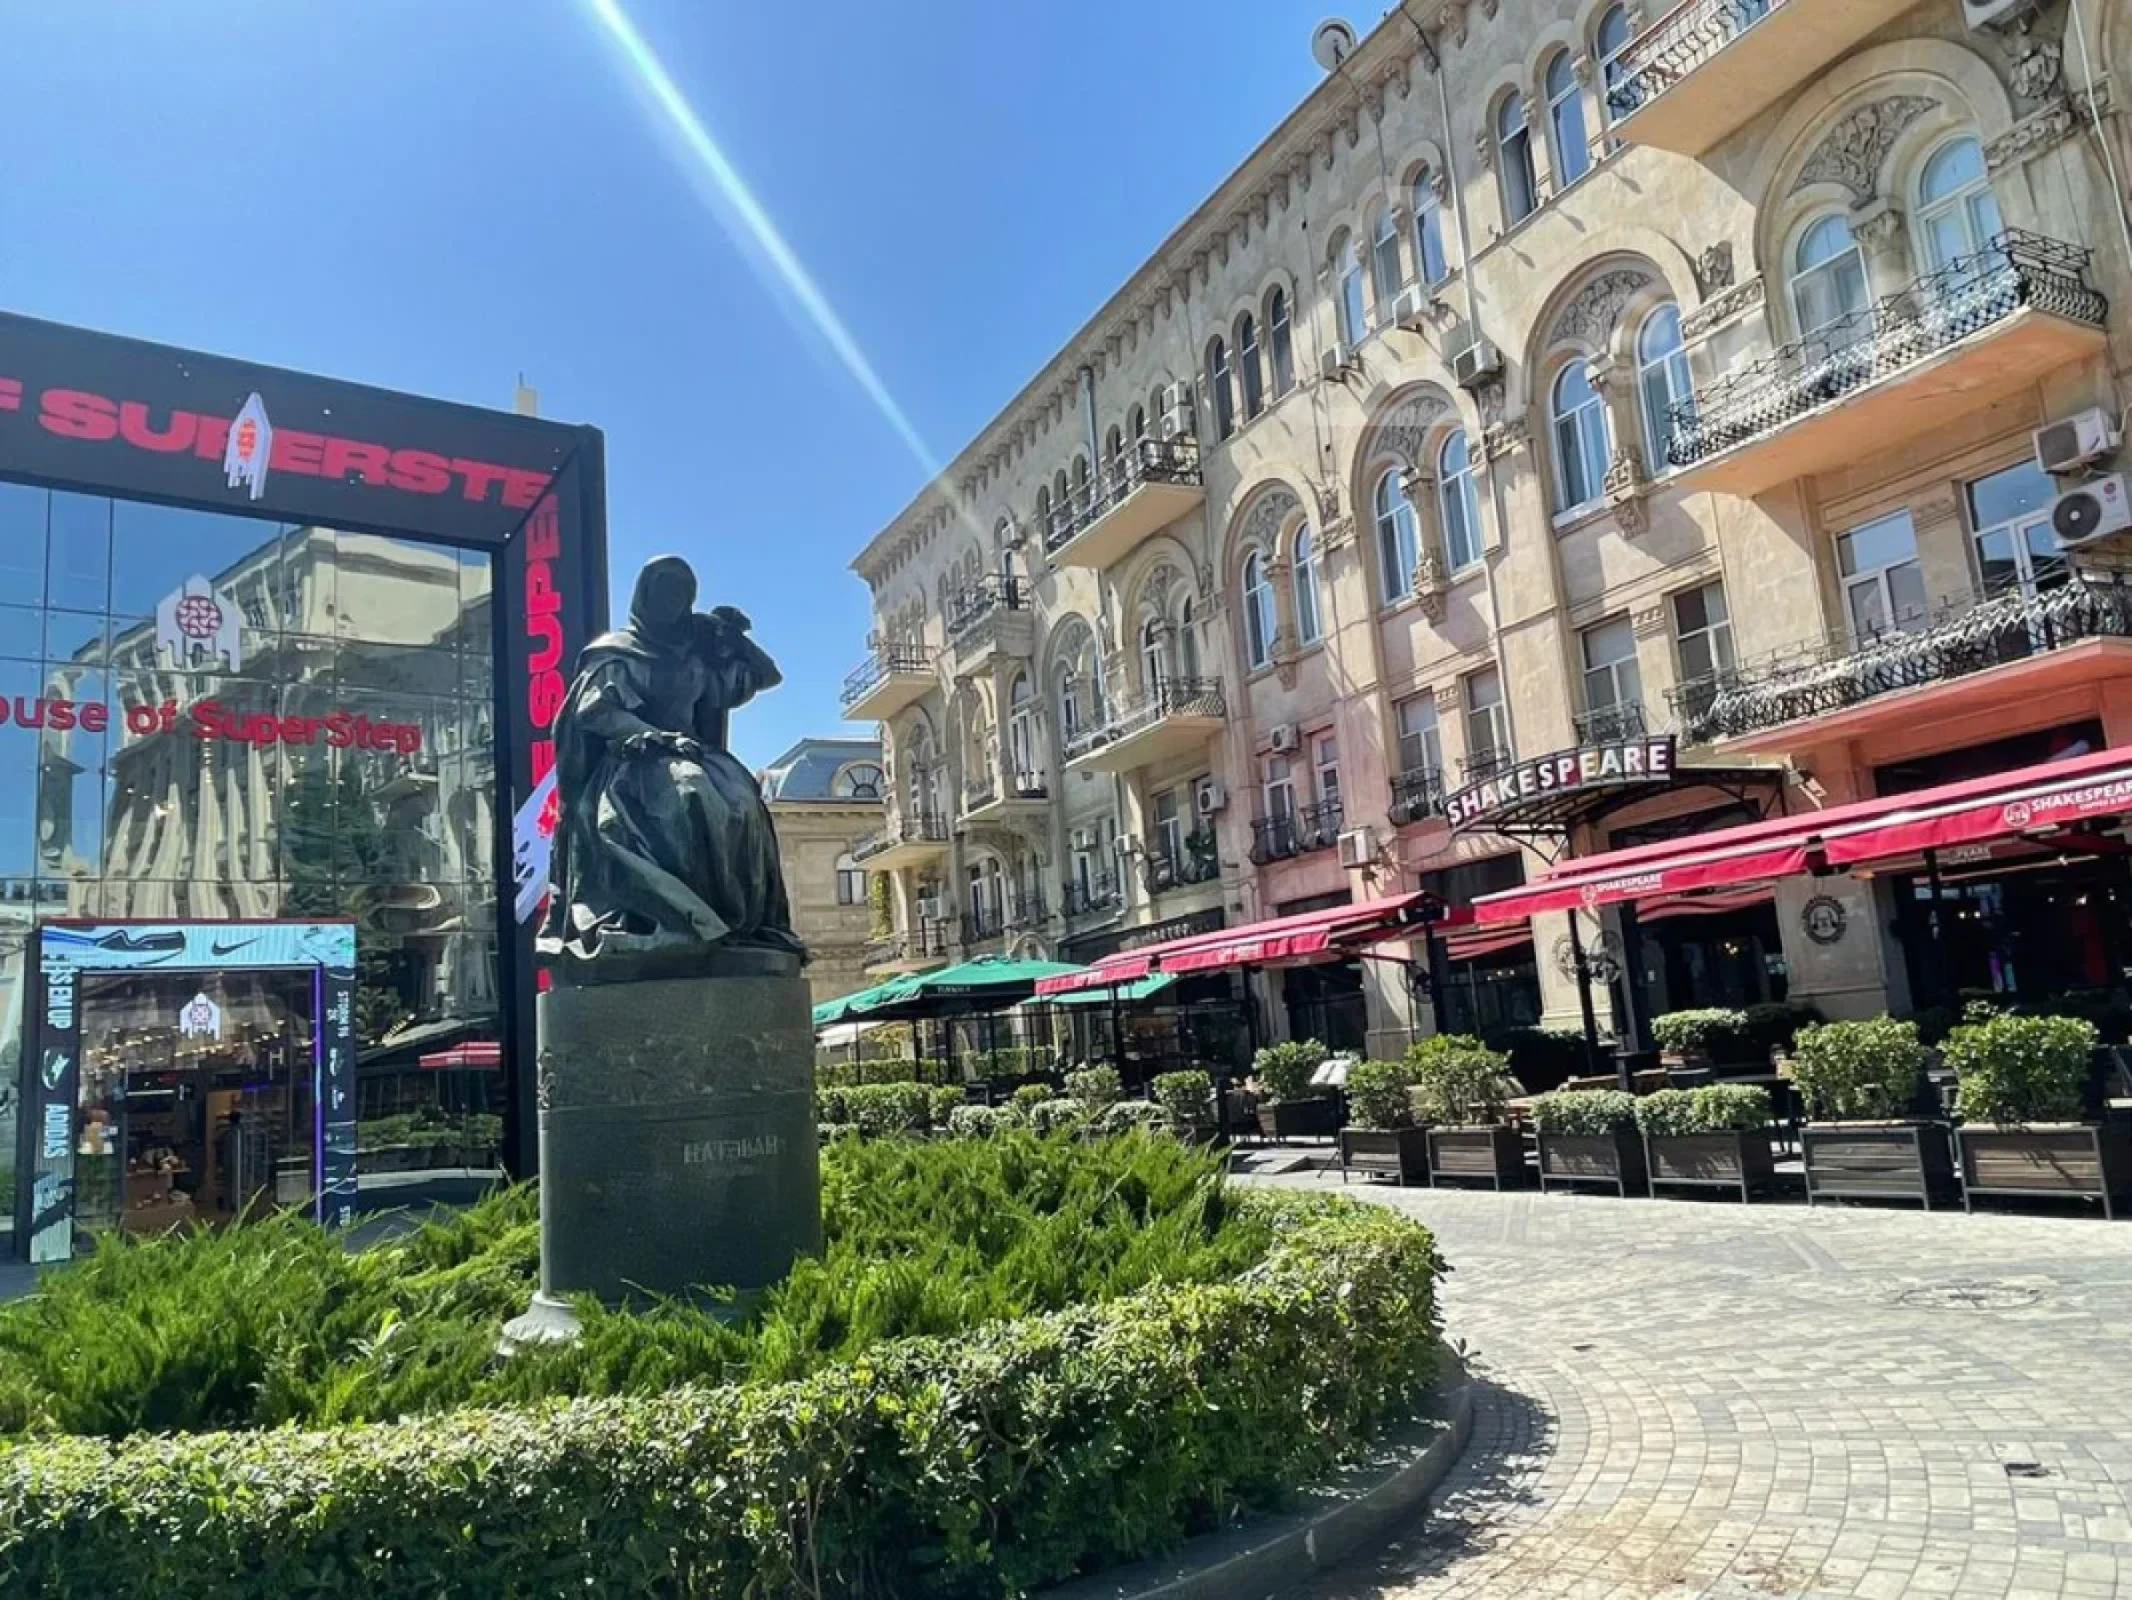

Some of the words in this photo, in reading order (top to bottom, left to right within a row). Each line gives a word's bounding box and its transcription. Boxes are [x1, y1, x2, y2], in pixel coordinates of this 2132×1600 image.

[128, 697, 178, 735] of
[191, 699, 423, 753] SuperStep
[1447, 743, 1667, 824] SHAKESPEARE
[44, 1104, 71, 1158] ADIDAS
